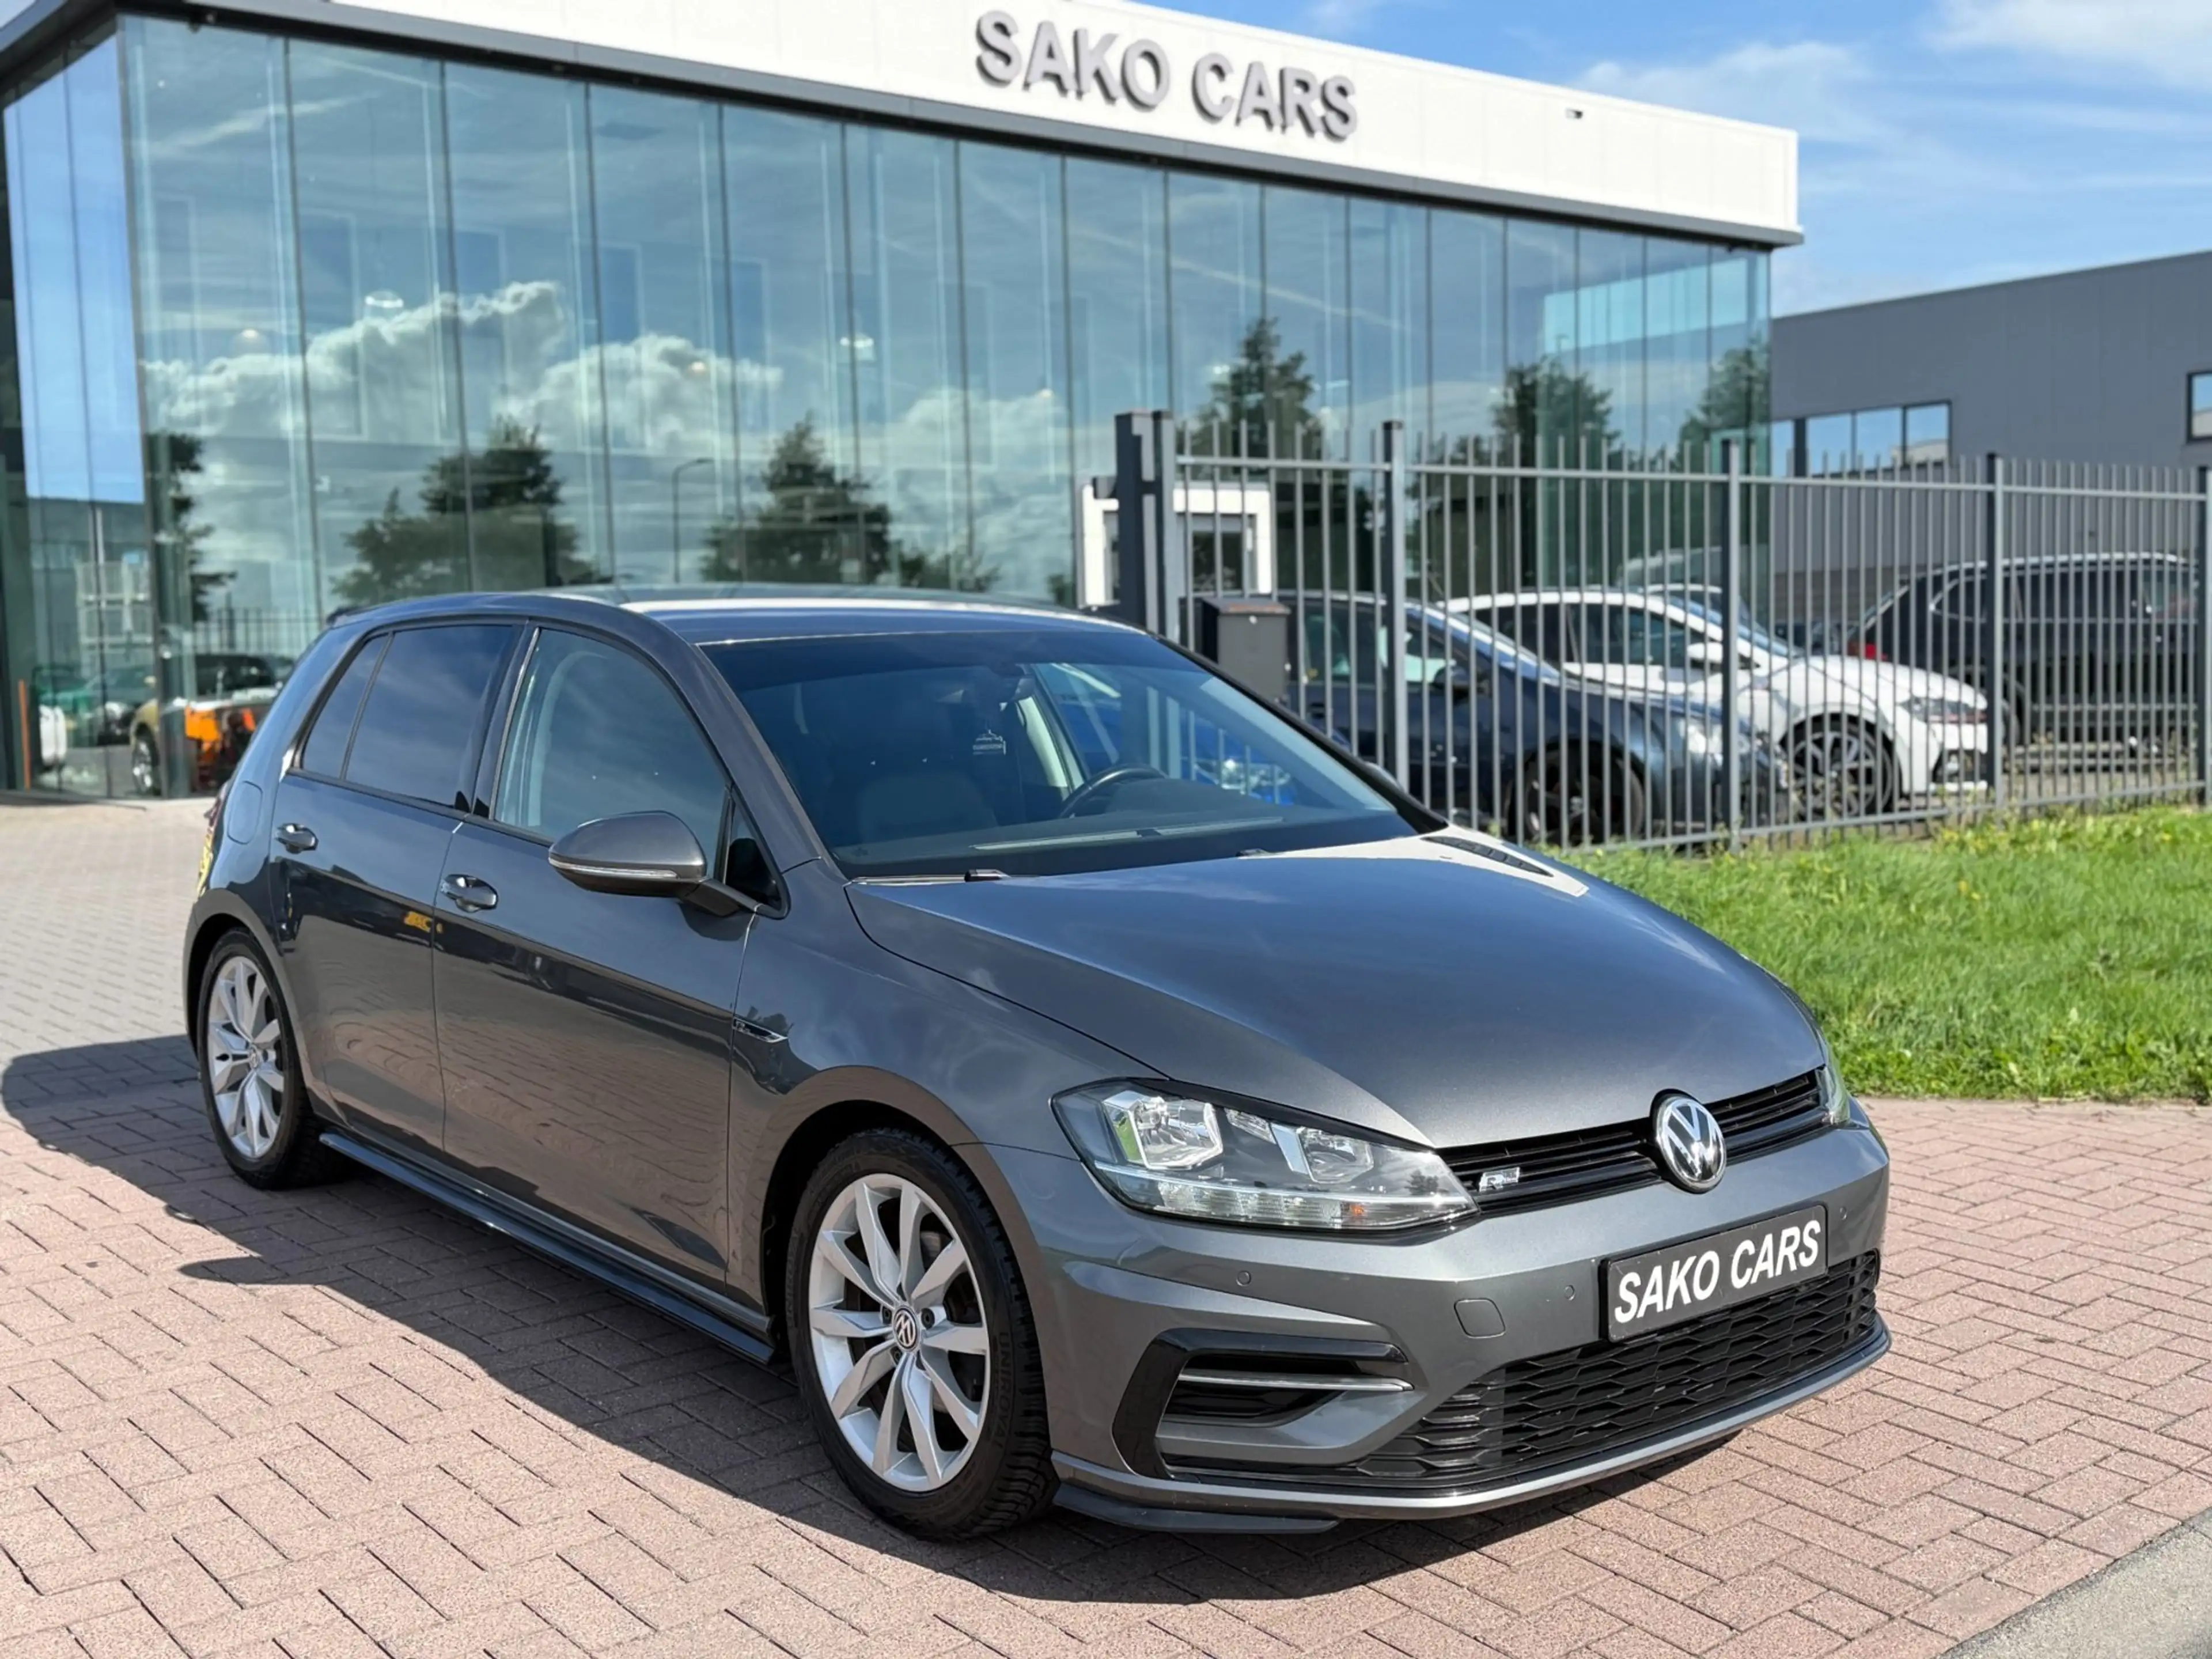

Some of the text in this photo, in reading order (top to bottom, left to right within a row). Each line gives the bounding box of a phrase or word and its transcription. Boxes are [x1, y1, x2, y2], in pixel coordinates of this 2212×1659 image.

[976, 10, 1358, 142] SAKO CARS
[1614, 1219, 1821, 1323] SAKO CARS
